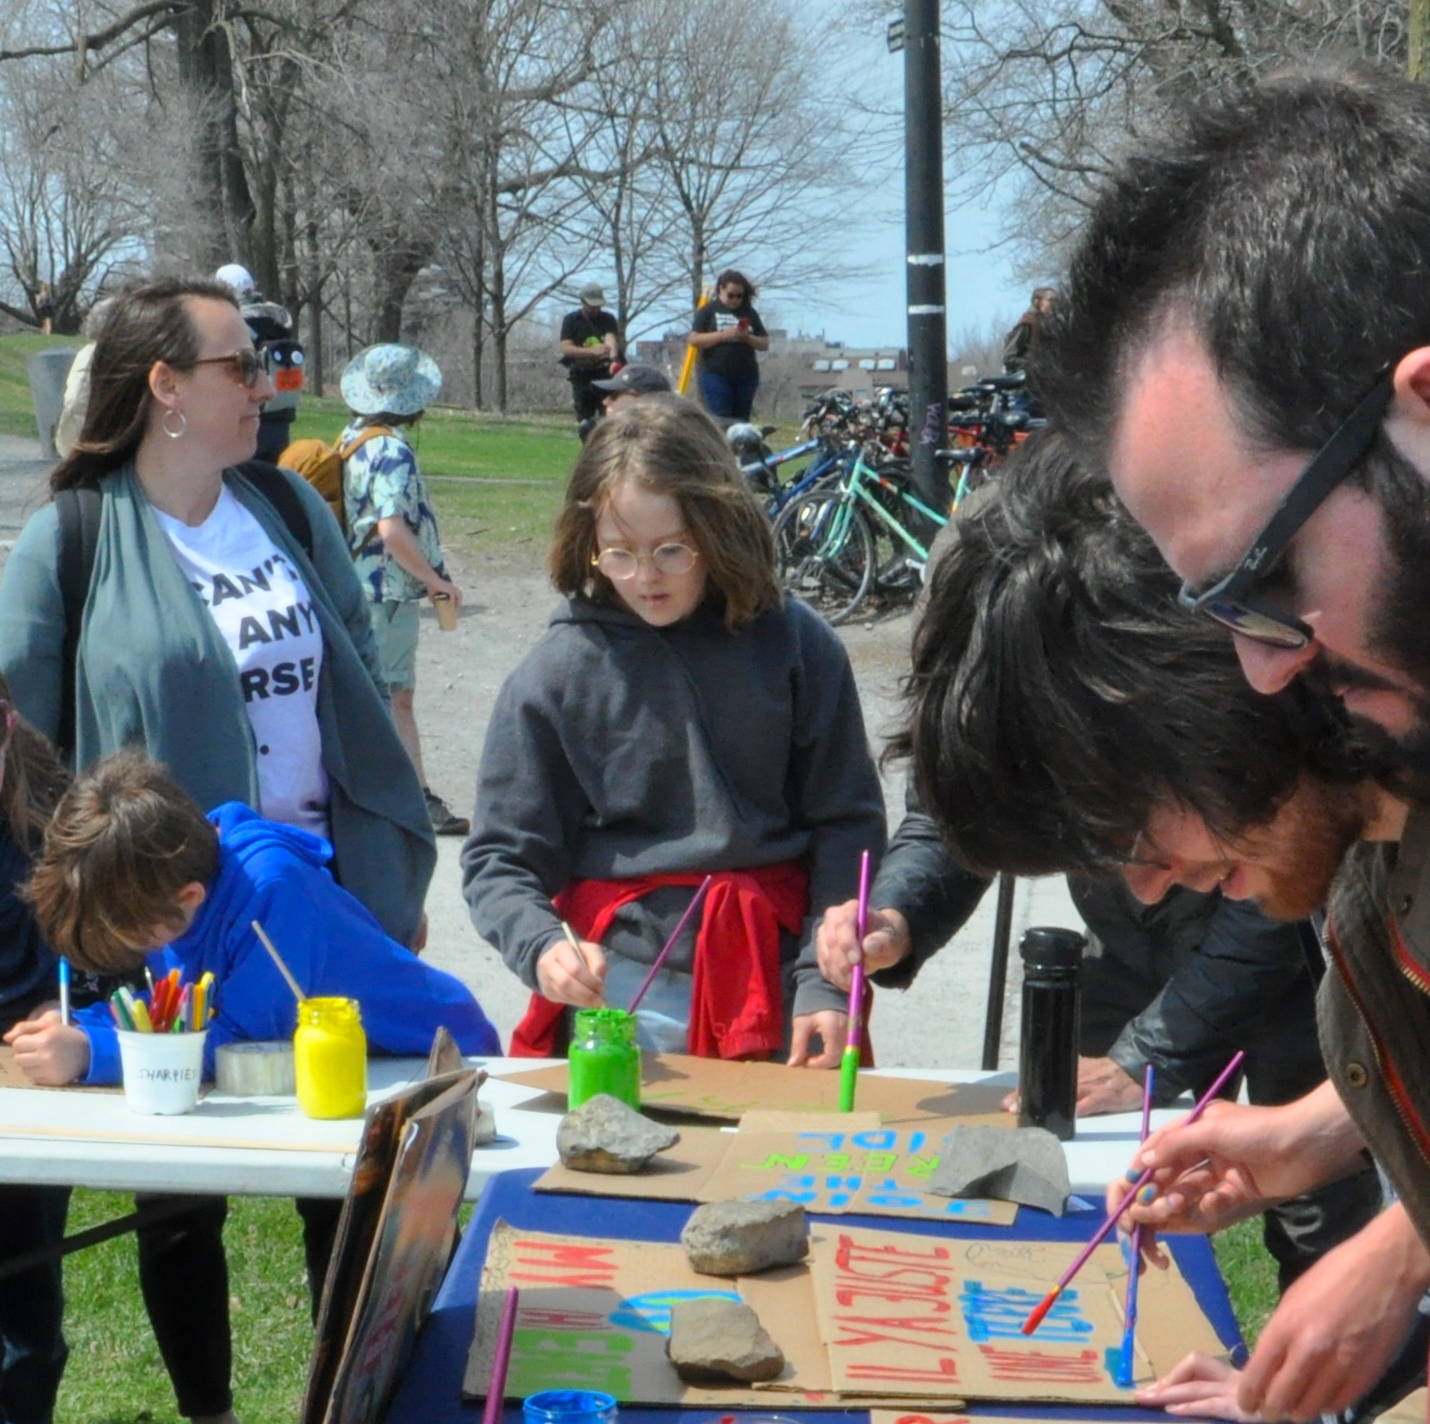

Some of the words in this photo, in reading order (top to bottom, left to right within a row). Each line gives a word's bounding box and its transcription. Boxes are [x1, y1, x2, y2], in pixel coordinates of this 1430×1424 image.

[239, 601, 314, 650] ANY
[138, 1067, 197, 1083] SHARPIES
[797, 1129, 950, 1153] IDE
[779, 1174, 923, 1195] THE
[508, 1241, 619, 1291] MY
[844, 1358, 961, 1384] IL
[977, 1344, 1104, 1384] UNE
